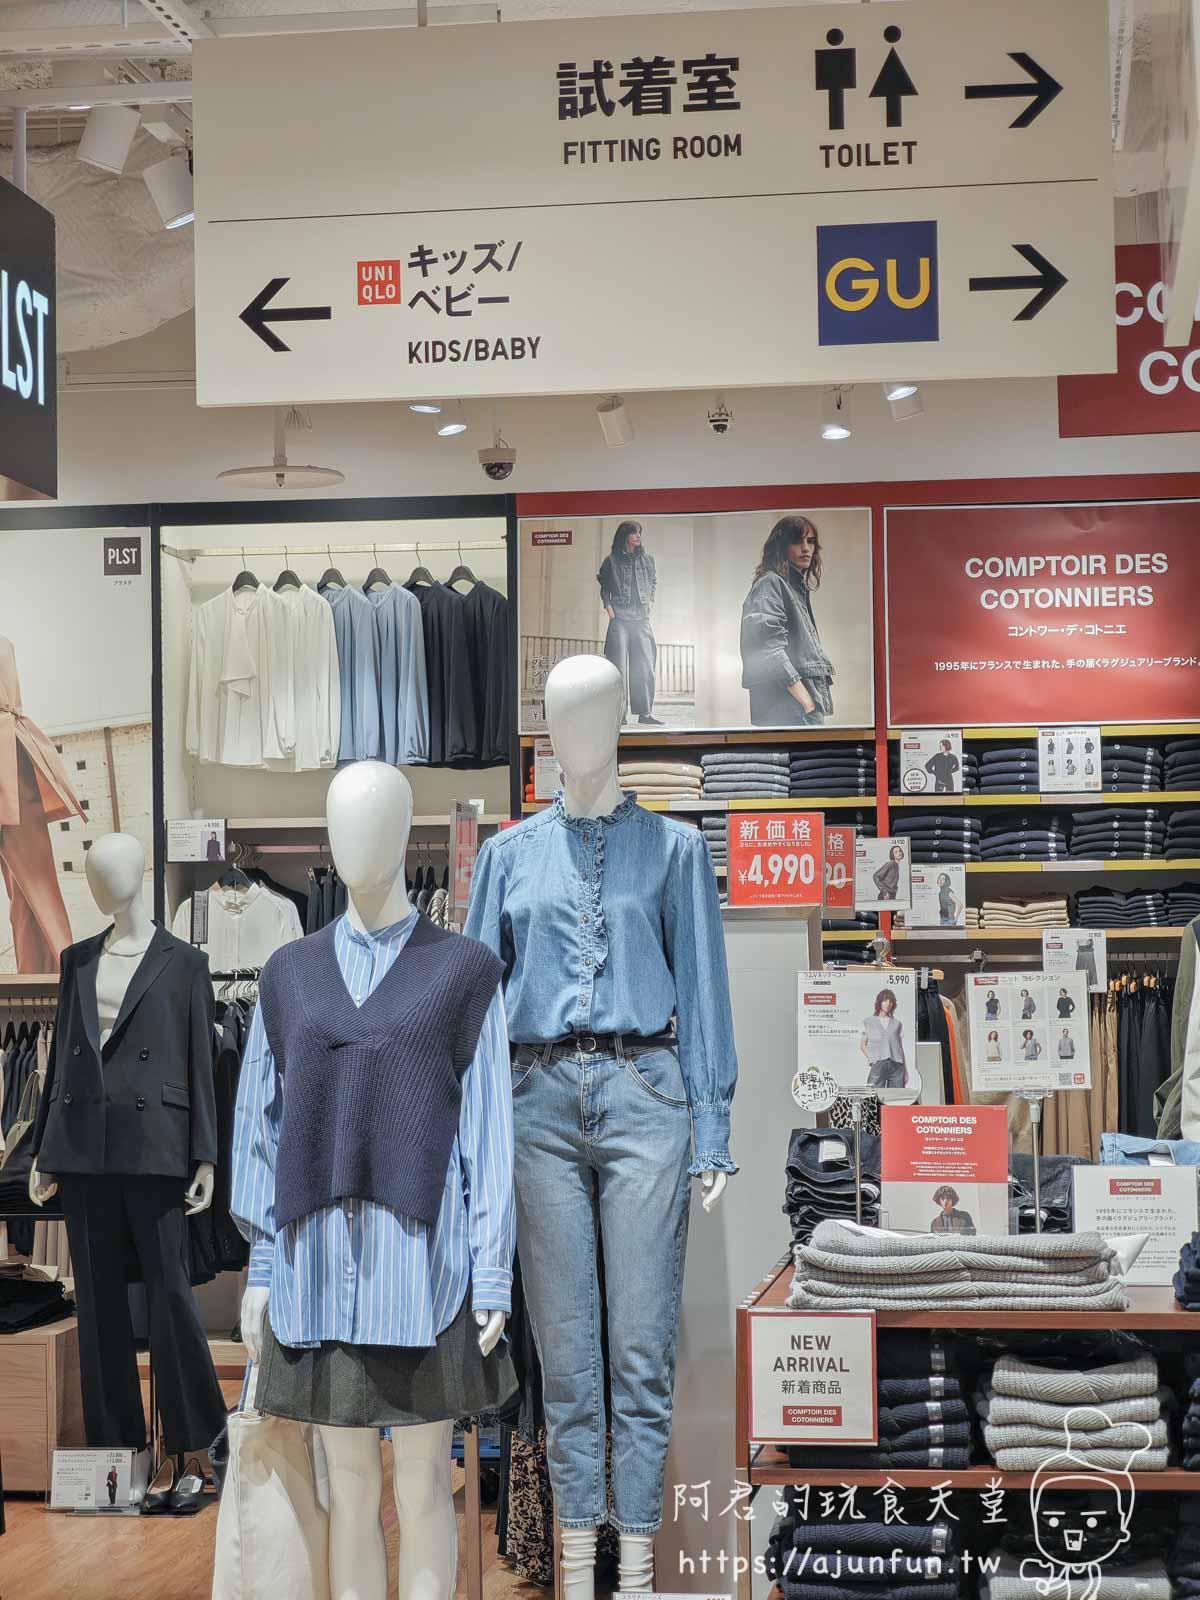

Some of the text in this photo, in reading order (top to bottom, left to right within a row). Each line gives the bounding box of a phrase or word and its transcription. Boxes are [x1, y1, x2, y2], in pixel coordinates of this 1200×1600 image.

[557, 53, 741, 120] 試着室
[563, 134, 742, 165] FITTING ROOM
[819, 141, 918, 169] TOILET
[407, 240, 523, 278] キッズ/
[361, 265, 393, 283] UNI
[361, 283, 397, 303] QLO
[825, 256, 931, 313] GU
[407, 285, 510, 319] ベビー
[407, 335, 542, 365] KIDS/BABY
[108, 547, 138, 565] PLST
[964, 552, 1169, 578] COMPTOIR DES
[979, 585, 1154, 609] COTONNIERS
[739, 819, 812, 839] 新価格
[738, 853, 815, 888] ¥4,990
[911, 1115, 977, 1125] COMPTOIR DES
[916, 1126, 973, 1135] COTONNIERS
[790, 1334, 832, 1351] NEW
[772, 1356, 850, 1373] ARRIVAL
[780, 1379, 843, 1395] 新着商品
[787, 1408, 823, 1416] COMPTOIR
[791, 1416, 834, 1424] COTONNIERS
